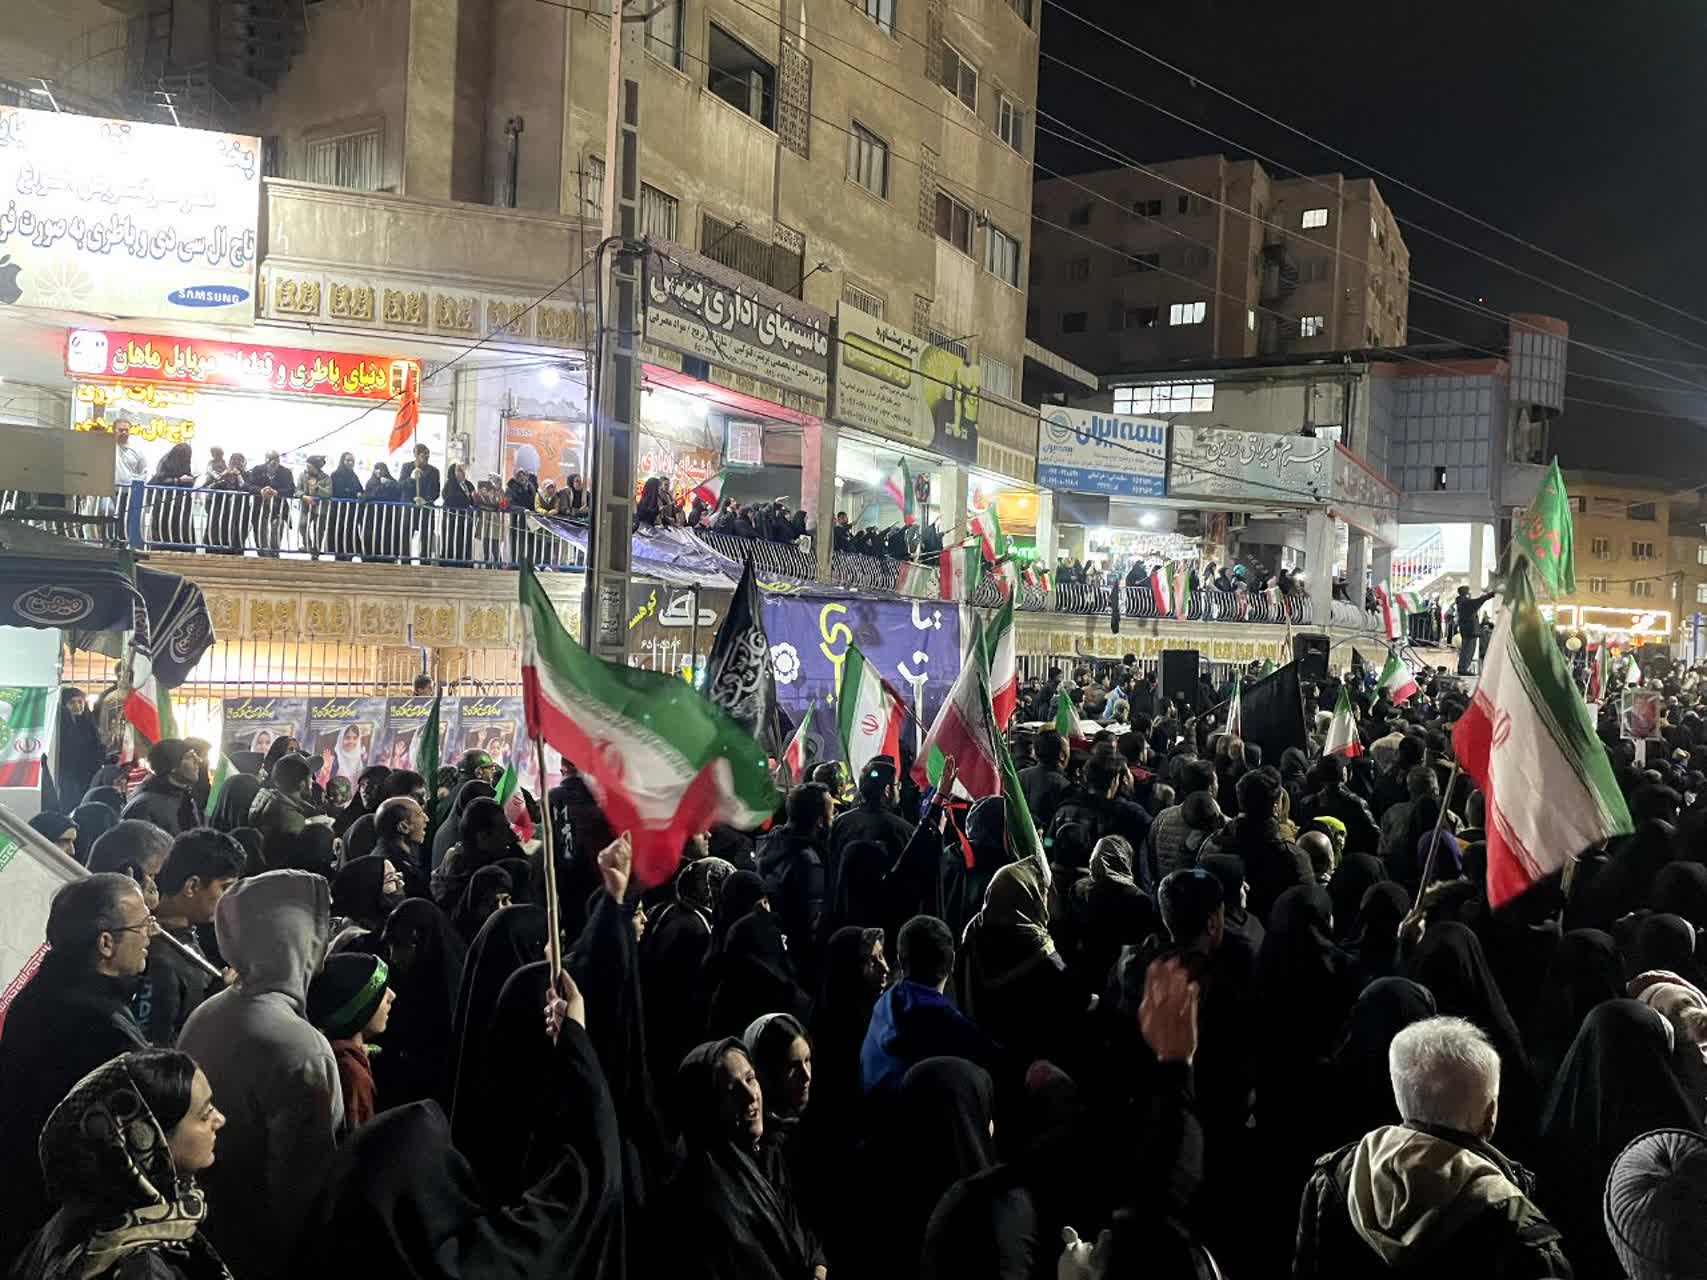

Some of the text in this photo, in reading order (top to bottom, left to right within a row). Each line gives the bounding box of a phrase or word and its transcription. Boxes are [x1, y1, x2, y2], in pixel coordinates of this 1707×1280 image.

[149, 224, 177, 261] دی
[177, 236, 206, 263] سی
[207, 224, 228, 266] ال
[177, 288, 241, 304] SAMSUNG
[703, 285, 760, 332] اداری
[758, 303, 829, 357] ماشینهای
[110, 339, 161, 375] ماهان
[288, 355, 341, 391] باطری
[275, 363, 288, 388] و
[342, 360, 388, 393] دنیای
[1075, 415, 1164, 455] بیمه ایران
